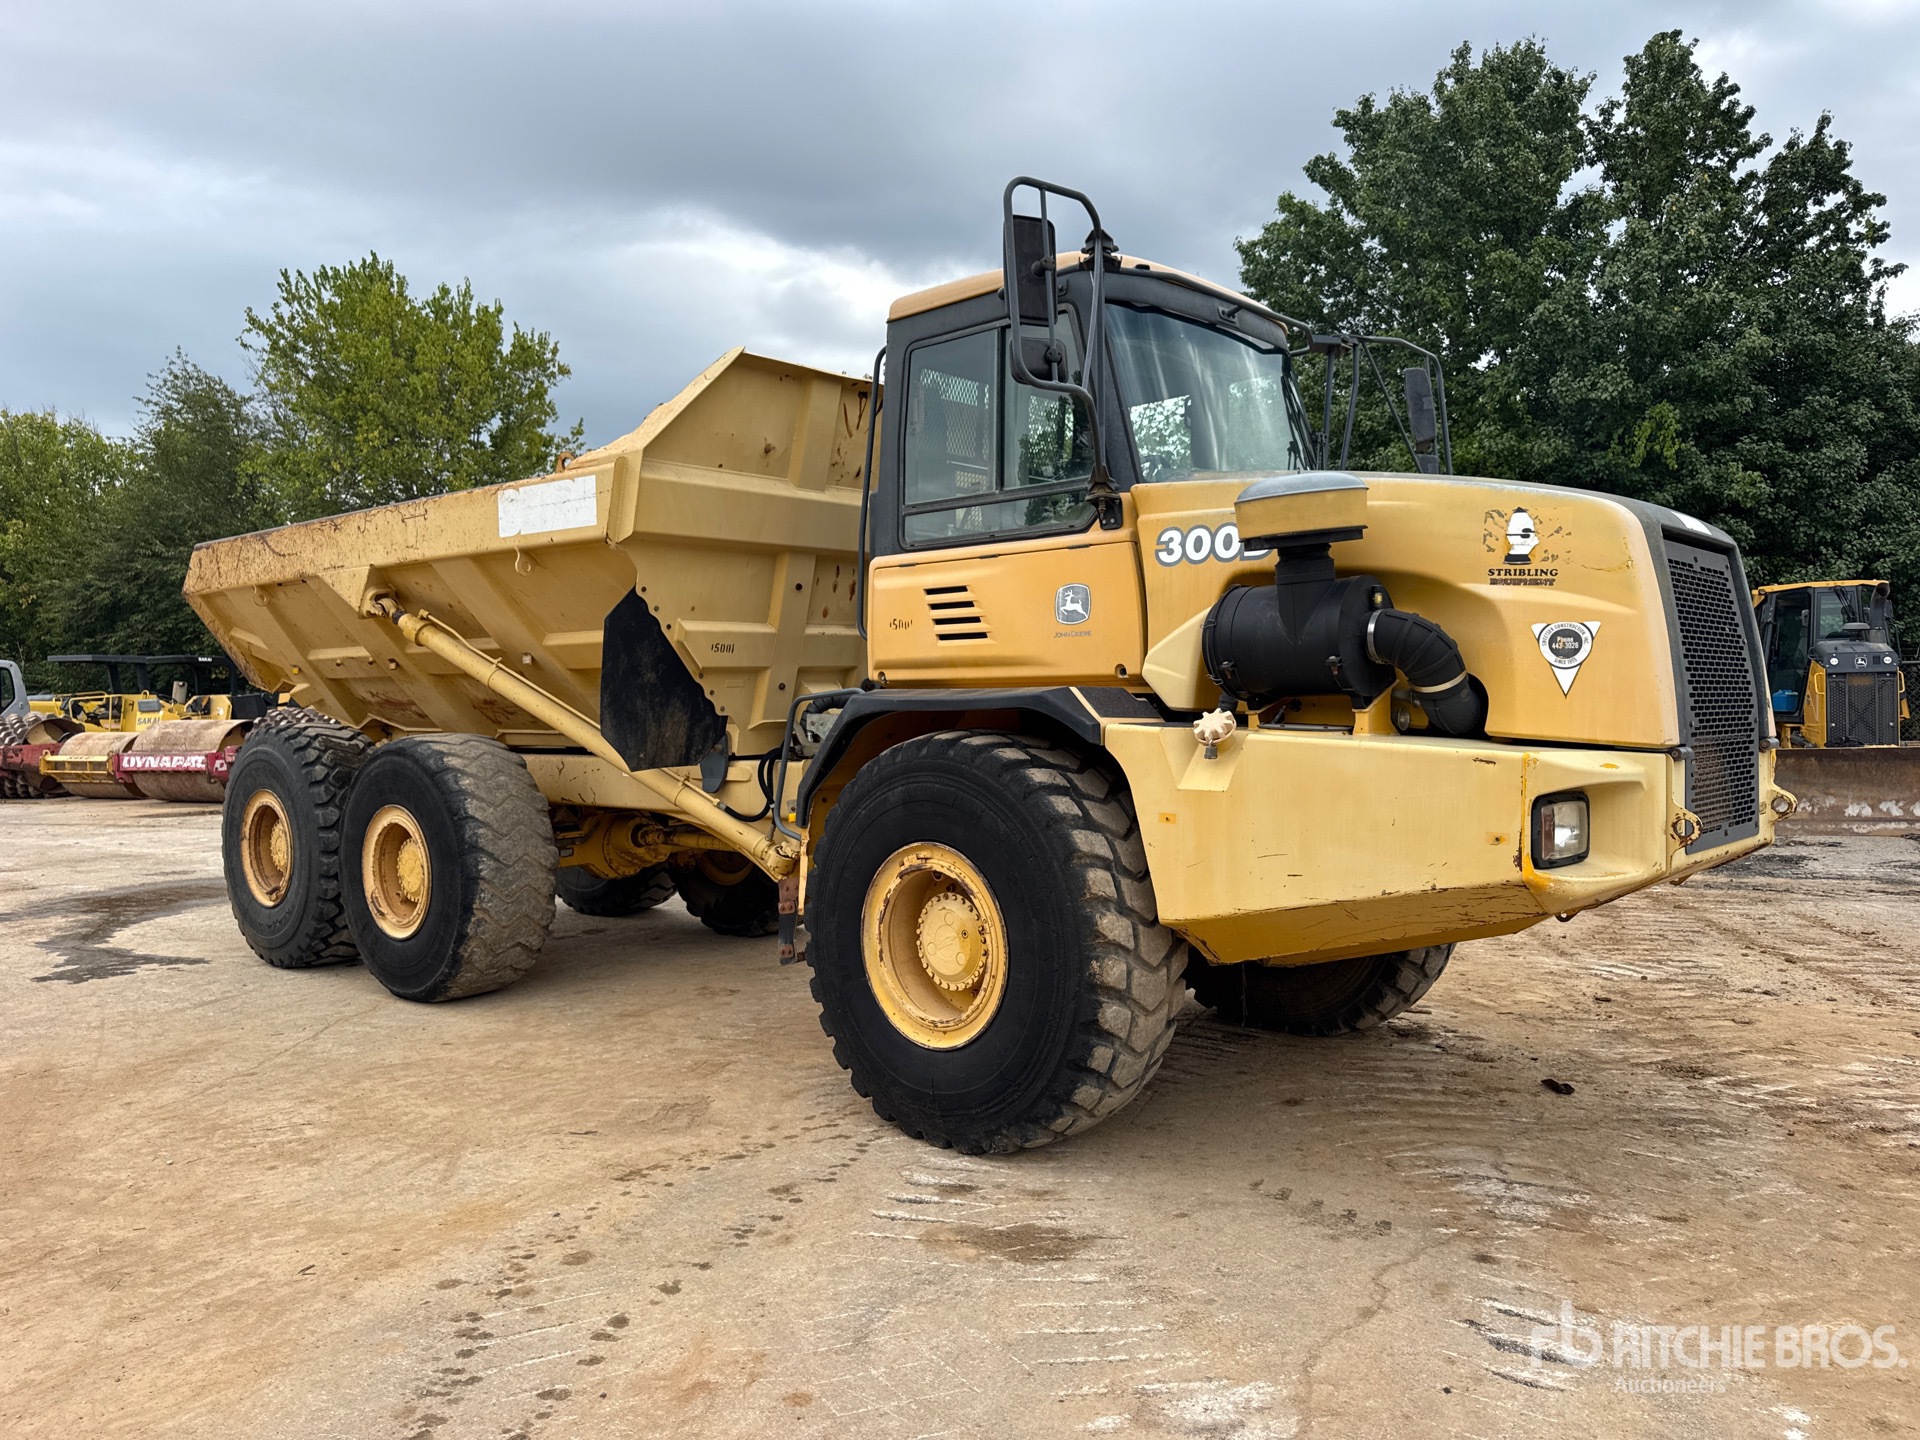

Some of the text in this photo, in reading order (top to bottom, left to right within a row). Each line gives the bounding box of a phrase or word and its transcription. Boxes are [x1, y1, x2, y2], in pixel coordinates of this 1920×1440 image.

[1154, 522, 1274, 567] 300
[1487, 568, 1558, 576] STRIBLING
[122, 756, 206, 768] DYNAPAC
